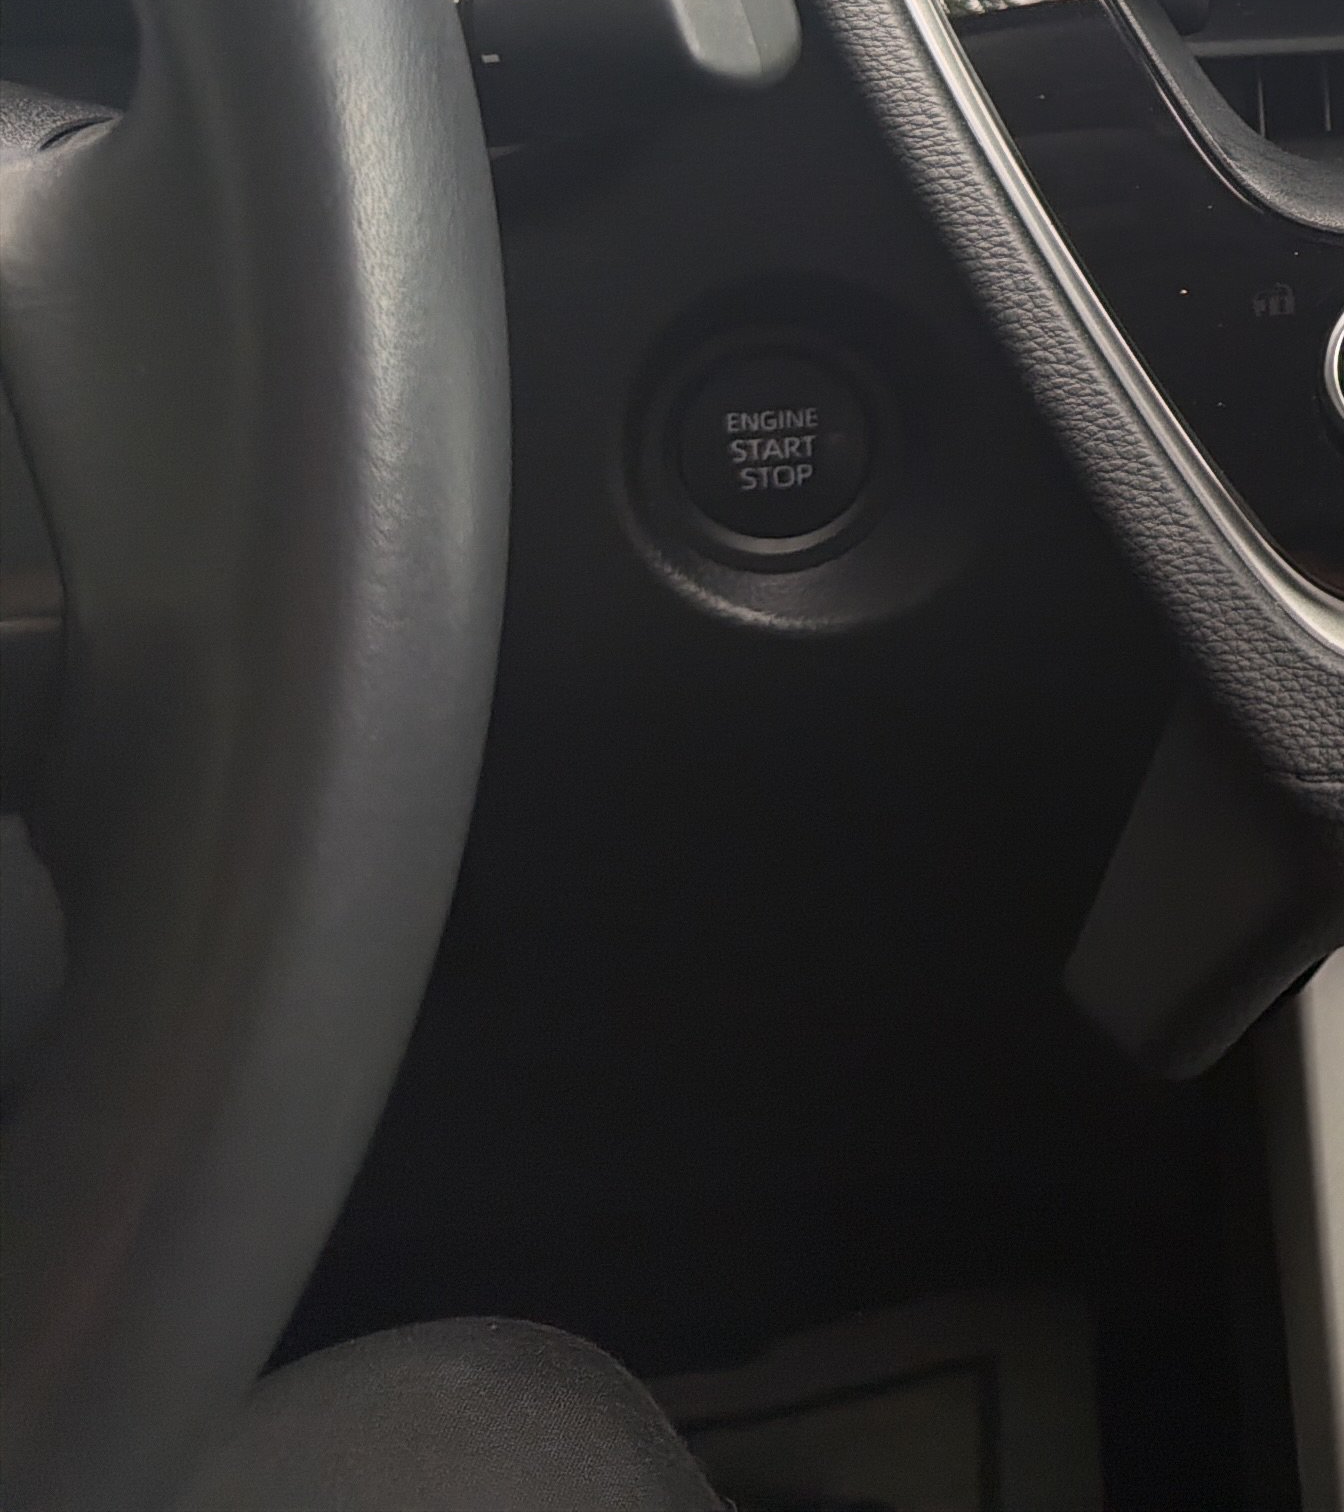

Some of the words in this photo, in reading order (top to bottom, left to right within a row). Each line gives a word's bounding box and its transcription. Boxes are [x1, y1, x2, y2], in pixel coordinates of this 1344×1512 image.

[726, 407, 819, 433] ENGINE
[730, 434, 817, 463] START
[740, 463, 814, 491] STOP
